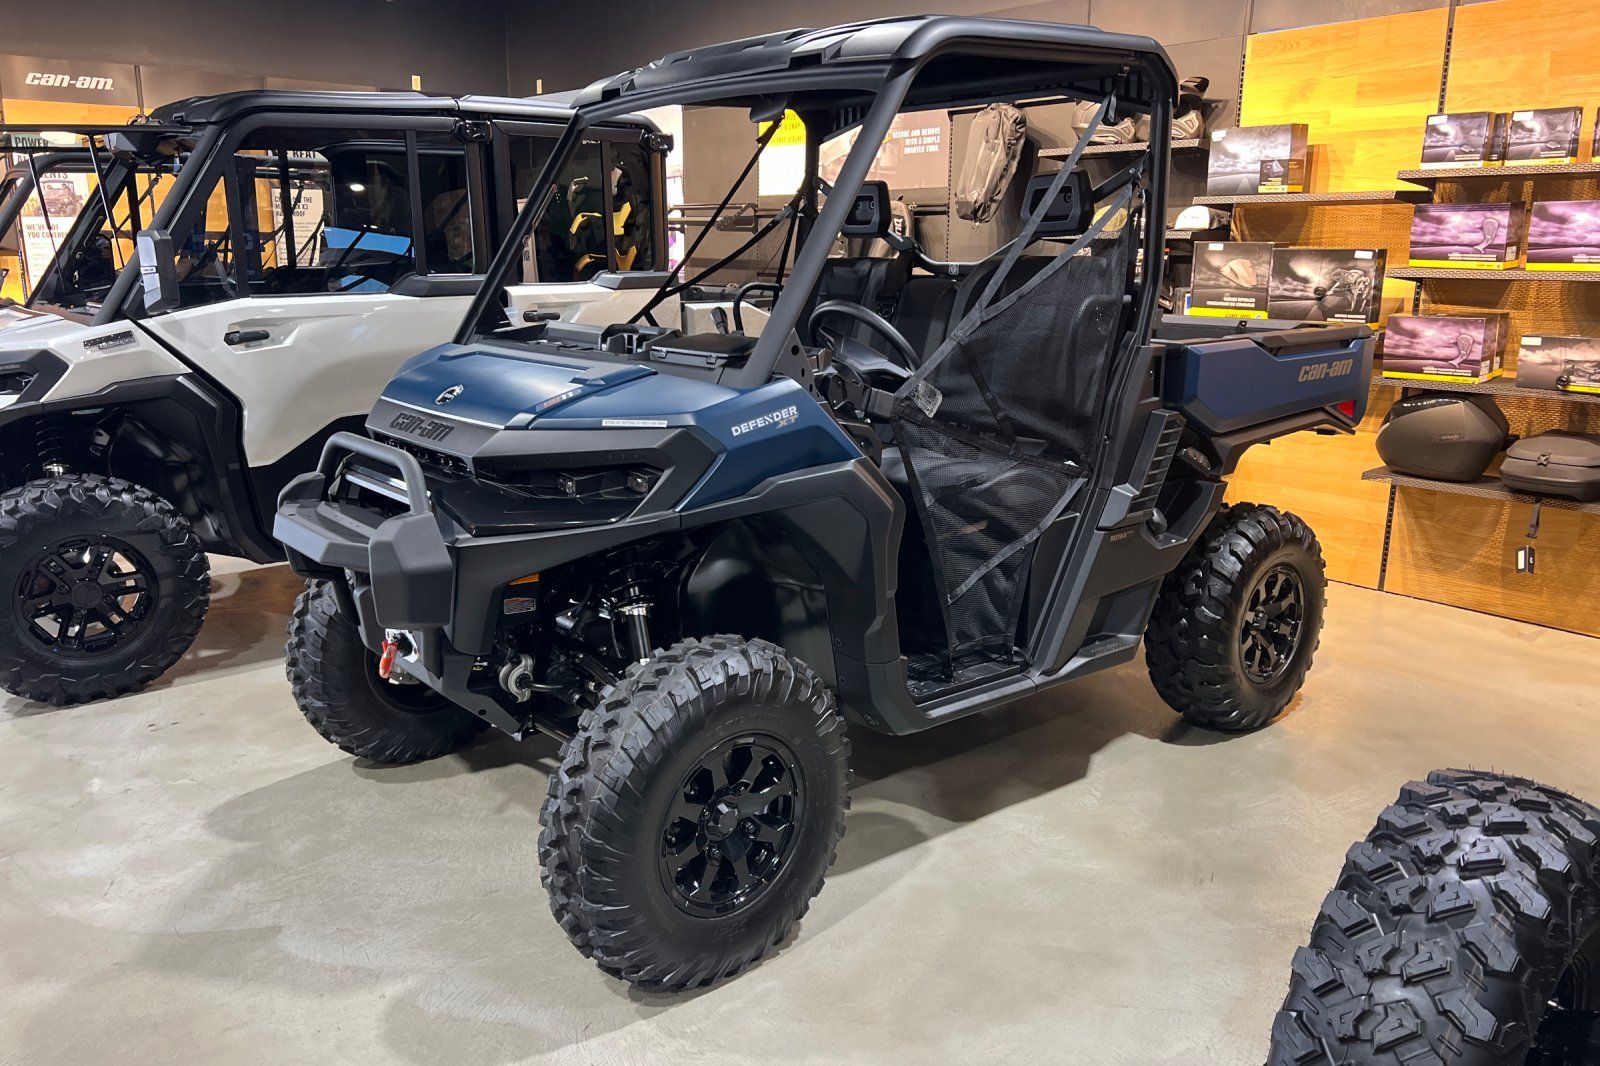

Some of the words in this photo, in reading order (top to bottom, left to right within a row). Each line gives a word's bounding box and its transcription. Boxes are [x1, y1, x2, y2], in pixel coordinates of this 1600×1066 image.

[905, 137, 918, 146] WITH
[923, 135, 941, 144] SIMPLE
[1298, 359, 1353, 382] can-am
[389, 412, 456, 442] can-am
[731, 405, 798, 436] DEFENDER
